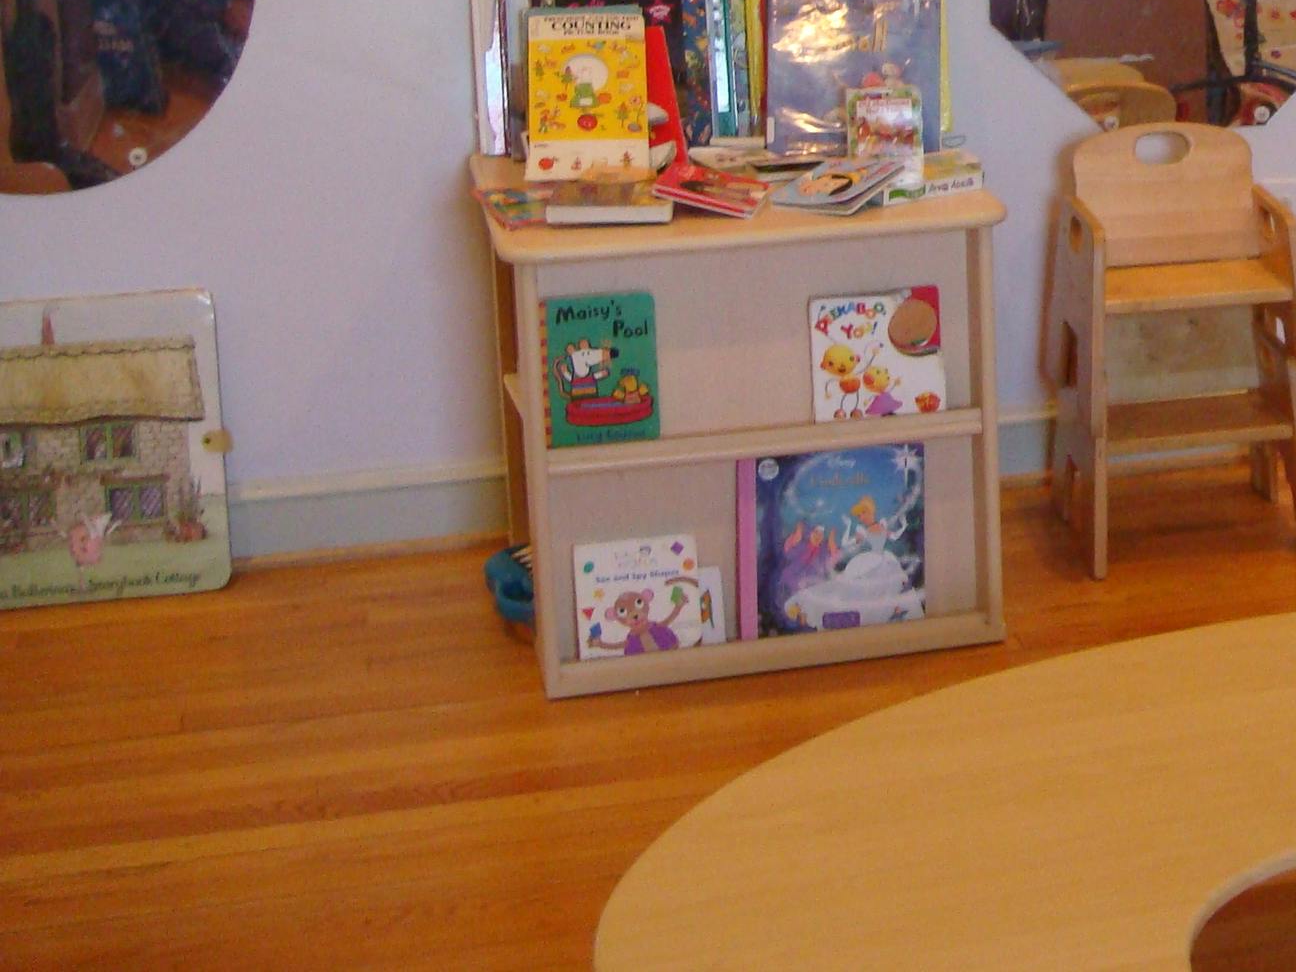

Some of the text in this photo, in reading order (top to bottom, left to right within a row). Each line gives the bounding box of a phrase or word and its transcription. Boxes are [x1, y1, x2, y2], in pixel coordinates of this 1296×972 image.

[551, 19, 633, 32] COUNTING
[555, 299, 623, 326] Maisy's
[612, 320, 649, 338] Pool
